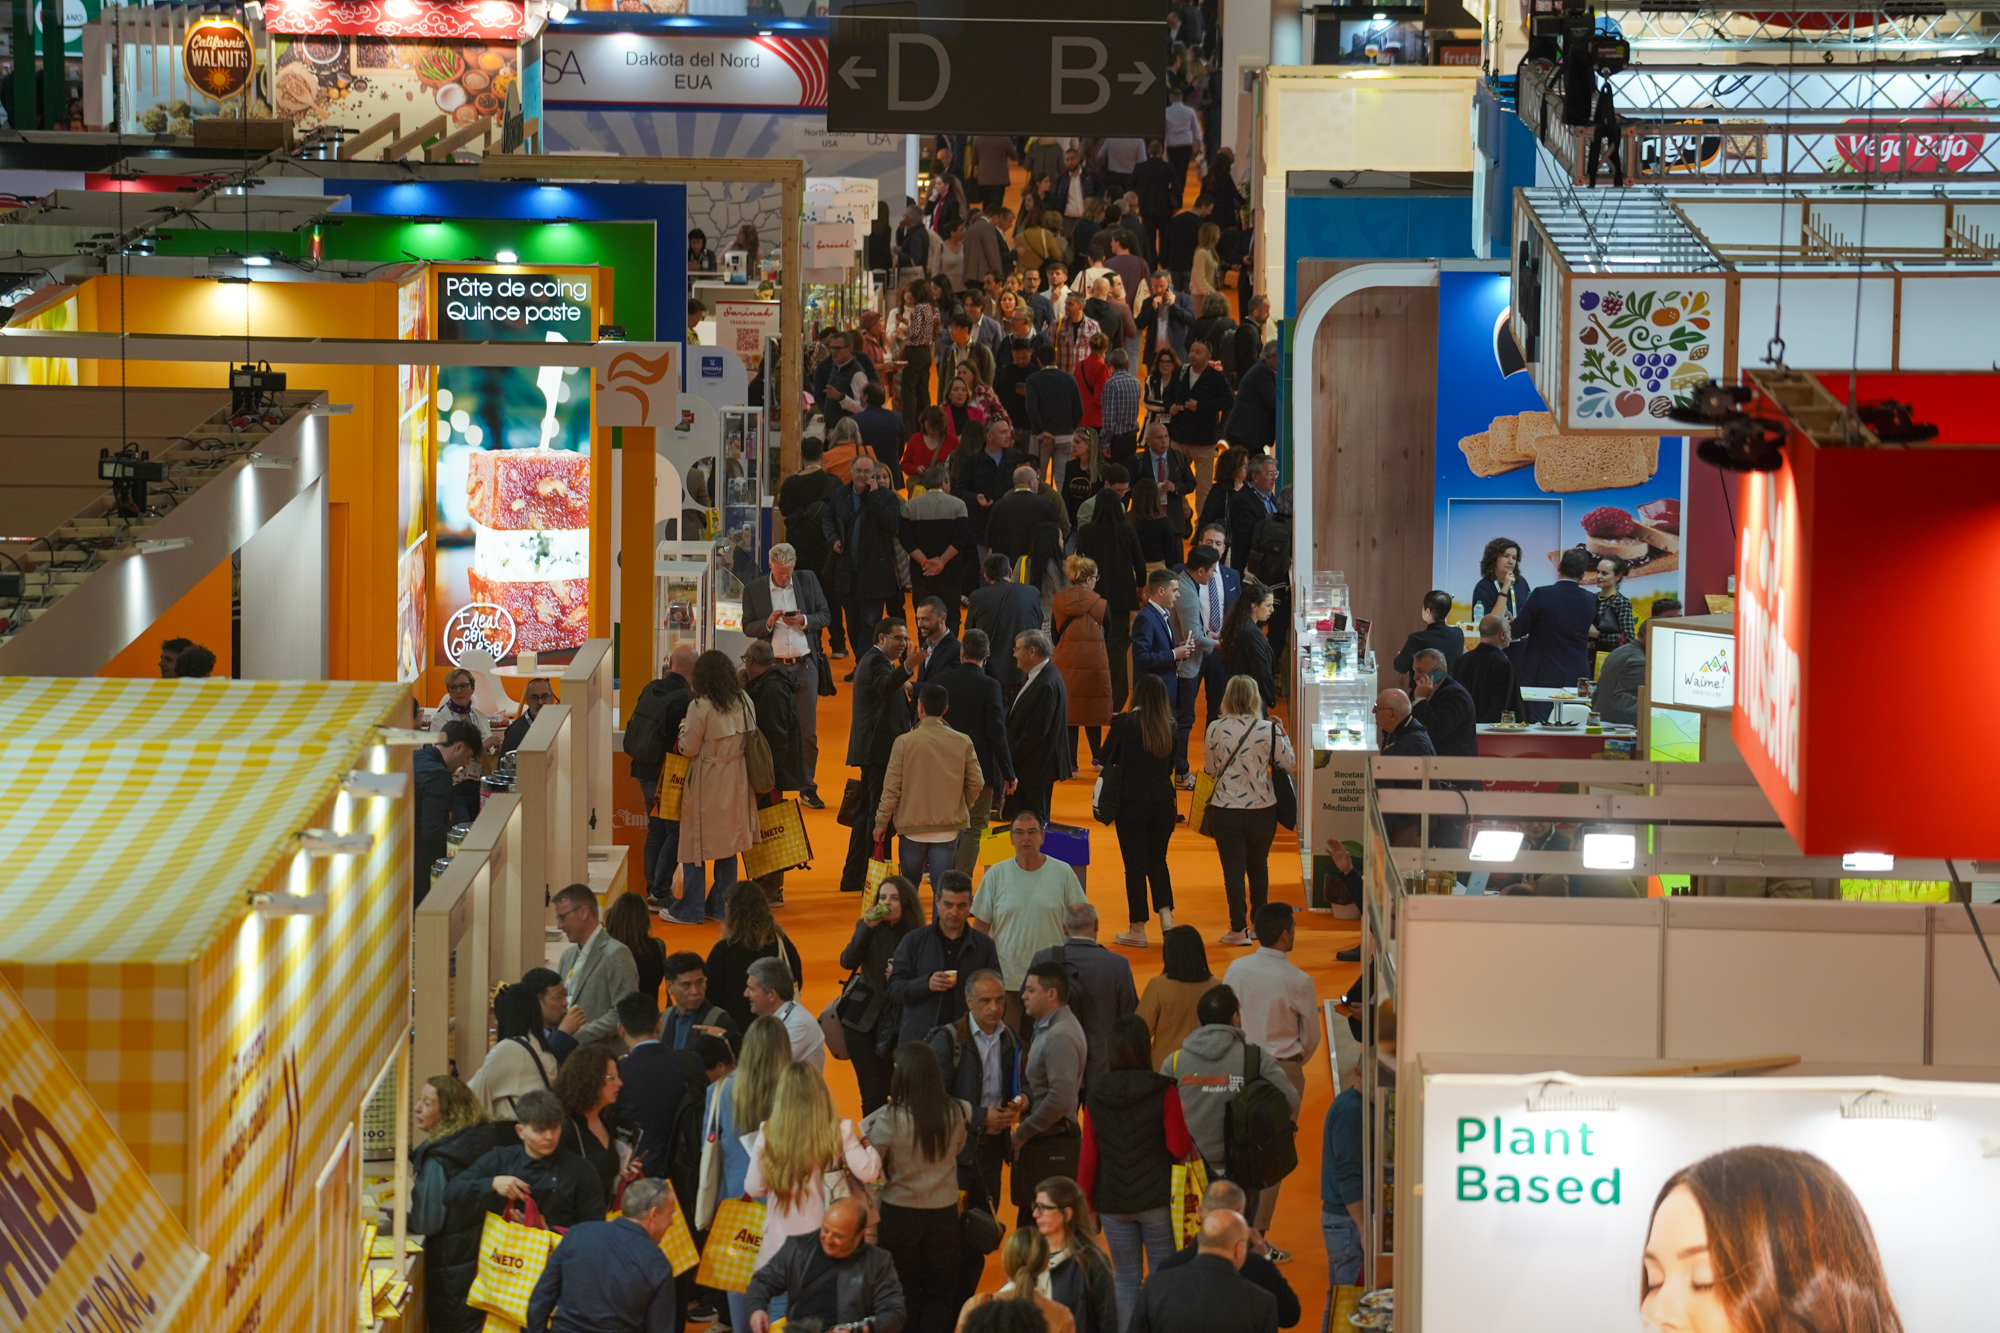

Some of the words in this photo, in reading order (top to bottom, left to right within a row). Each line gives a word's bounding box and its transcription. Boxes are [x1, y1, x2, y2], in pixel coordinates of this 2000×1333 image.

[191, 34, 246, 50] California
[191, 49, 248, 68] WALNUTS
[541, 49, 586, 85] SA
[626, 51, 684, 67] Dakota
[689, 53, 714, 68] del
[720, 53, 760, 69] Nord
[1443, 51, 1481, 66] fruta
[887, 32, 950, 111] D
[1050, 36, 1111, 114] B
[674, 74, 713, 90] EUA
[804, 129, 828, 137] North
[866, 133, 892, 146] USA
[822, 140, 838, 148] USA
[1849, 135, 1909, 163] Vega
[1913, 134, 1969, 163] Baja
[446, 277, 493, 297] Pâte
[497, 278, 526, 297] de
[530, 279, 587, 302] coing
[446, 301, 521, 321] Quince
[525, 302, 582, 325] paste
[723, 306, 774, 318] Sarinah
[456, 610, 502, 630] Ideal
[463, 629, 486, 642] con
[1684, 672, 1726, 688] Waime!
[669, 774, 685, 786] ANE
[1457, 1116, 1594, 1156] Plant
[1457, 1165, 1621, 1205] Based
[734, 1228, 763, 1247] ANE
[489, 1247, 524, 1269] ANETO
